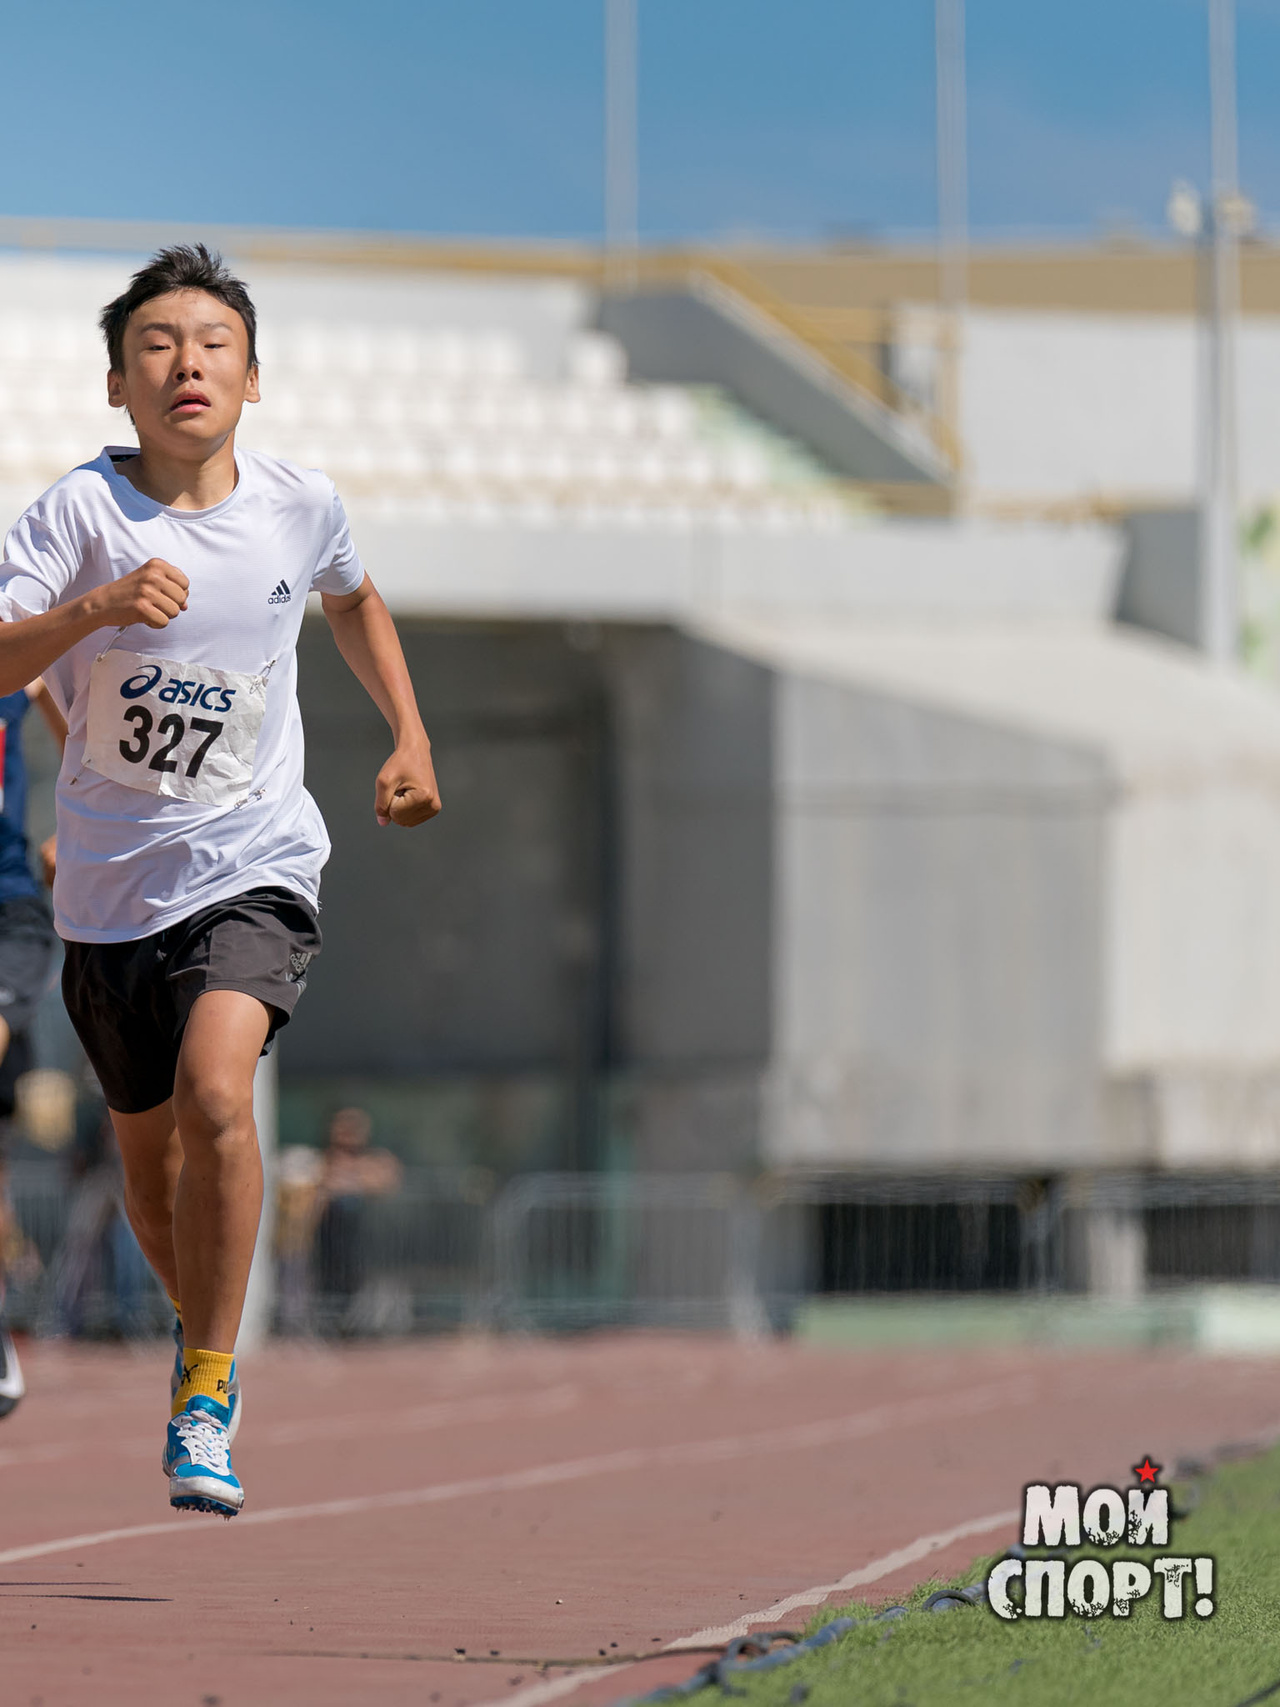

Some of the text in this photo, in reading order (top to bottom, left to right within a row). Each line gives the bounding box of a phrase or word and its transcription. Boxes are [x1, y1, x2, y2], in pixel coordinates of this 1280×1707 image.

[267, 594, 291, 604] adids
[158, 678, 236, 712] asics
[119, 704, 224, 778] 327
